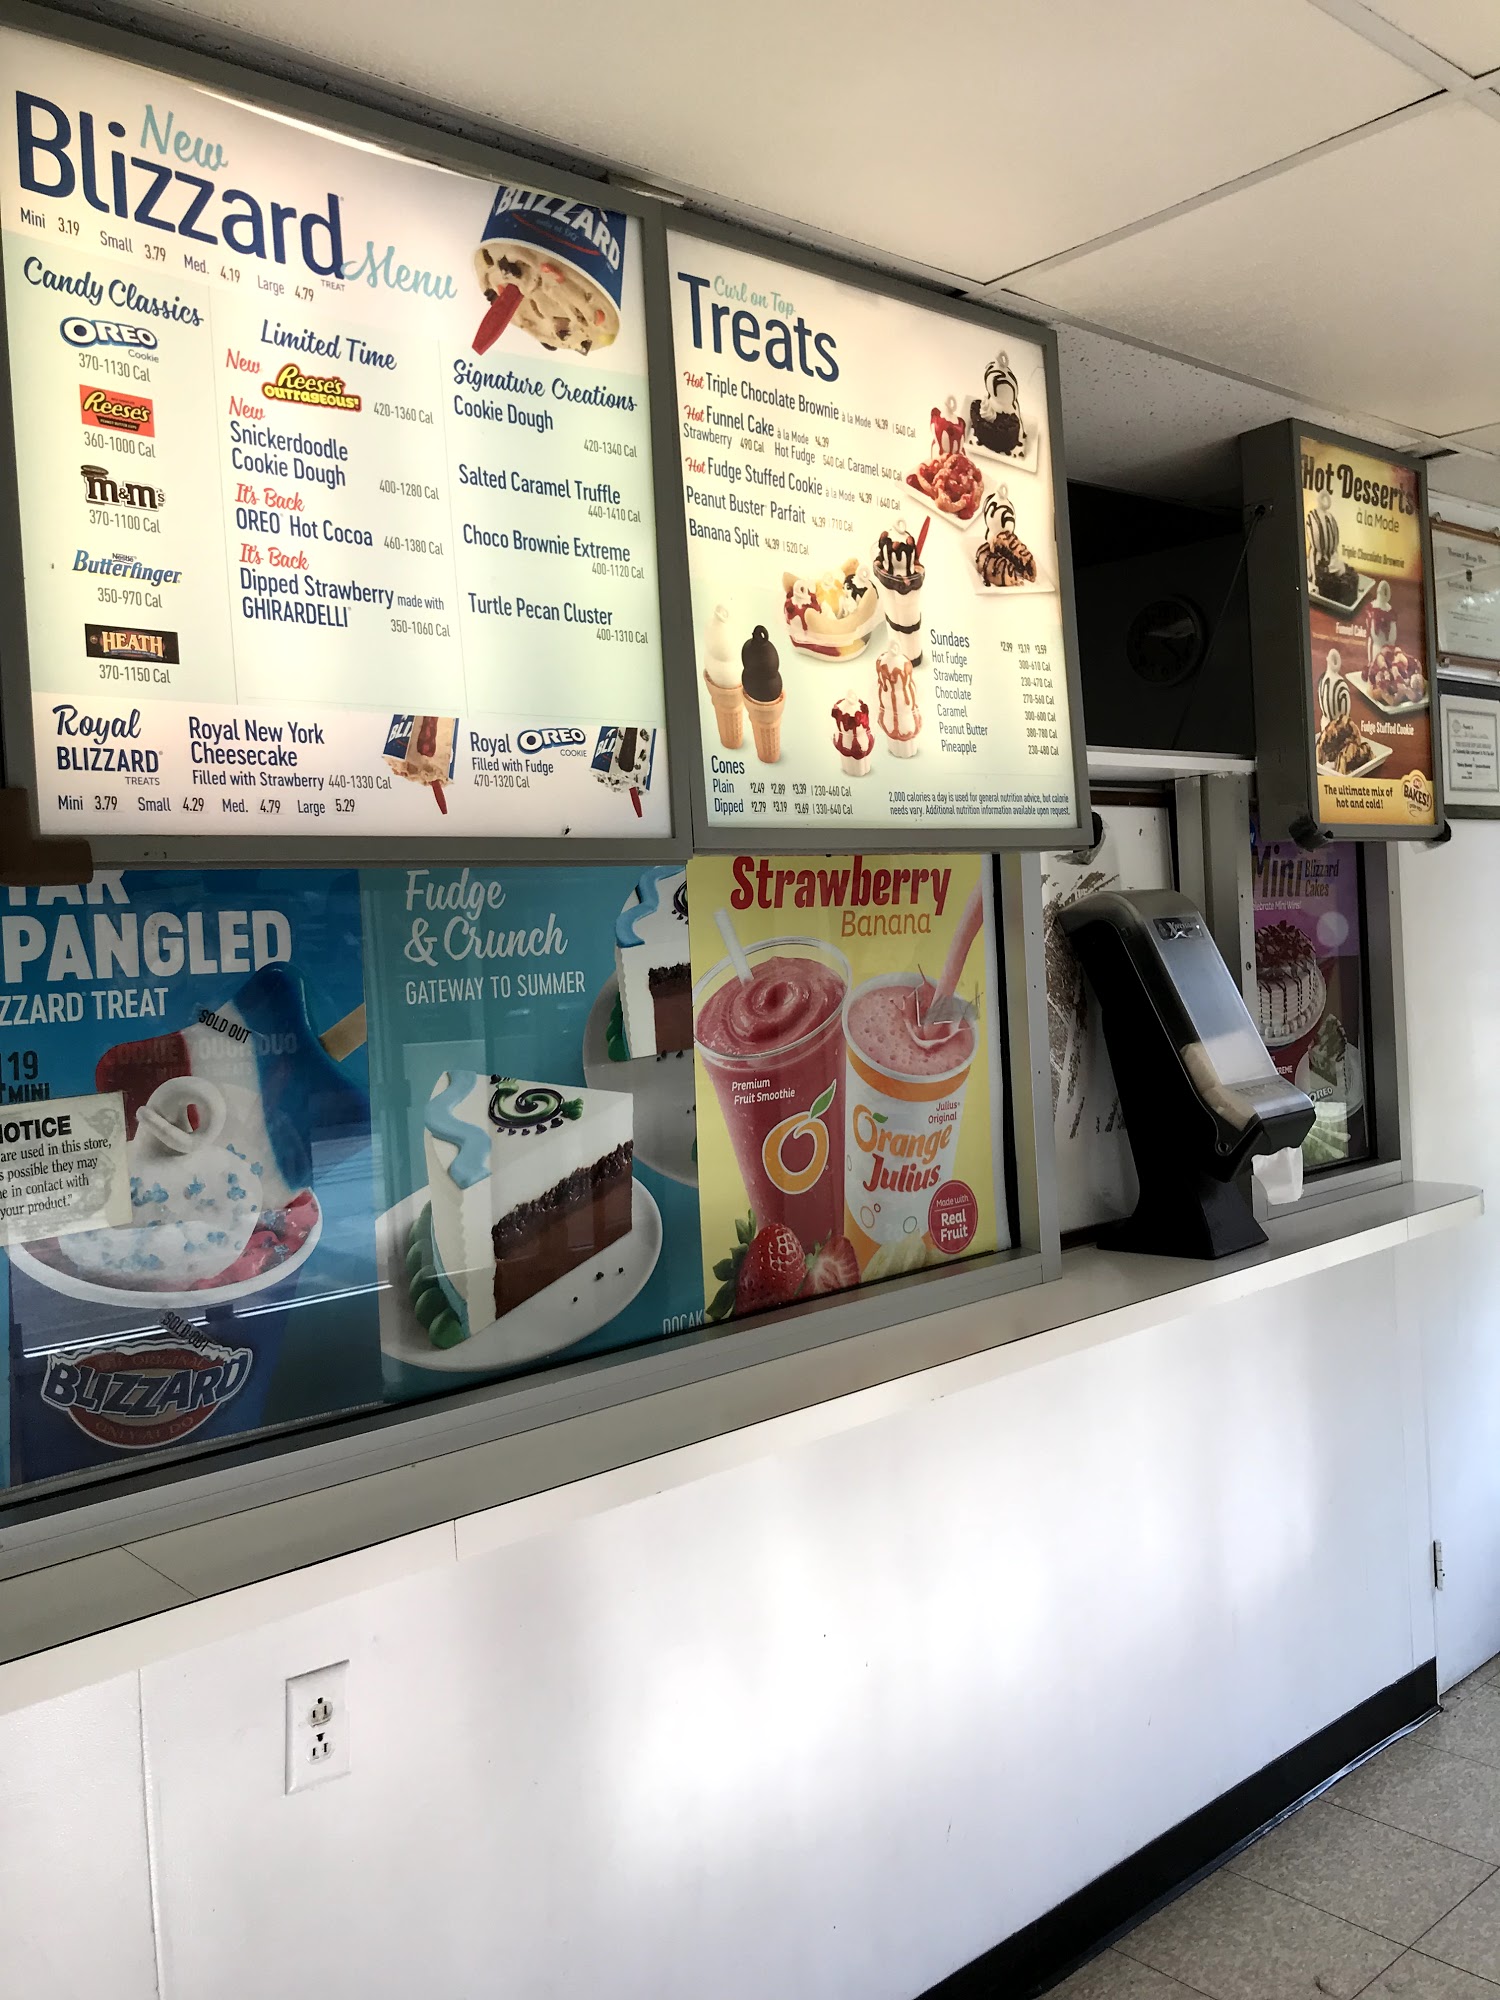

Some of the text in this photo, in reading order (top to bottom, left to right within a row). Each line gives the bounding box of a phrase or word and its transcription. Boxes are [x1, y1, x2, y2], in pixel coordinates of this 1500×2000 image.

[140, 104, 228, 171] New
[16, 90, 345, 279] Blizzard
[20, 207, 314, 302] Mini 3.19 Small 3.79 Med. 4.19 Large 4.79
[341, 241, 457, 299] Menu
[24, 256, 204, 326] Candy Classics
[714, 276, 796, 319] Curl on Top
[60, 317, 158, 349] OREO
[678, 272, 840, 382] Treats
[261, 318, 397, 371] Limited Time
[79, 353, 151, 382] 370-1130 Cal
[226, 348, 262, 374] New
[453, 359, 638, 411] Signature Creations
[683, 372, 840, 420] Hot Triple Chocolate Brownie
[83, 391, 151, 422] Reese's
[229, 395, 265, 420] New
[453, 395, 554, 433] Cookie Dough
[683, 405, 774, 436] Hot Funnel Cake
[230, 421, 348, 461] Snickerdoodle
[683, 423, 879, 477] Strawberry Hot Fudge Caramel
[232, 448, 346, 489] Cookie Dough
[684, 457, 823, 495] Hot Fudge Stuffed Cookie
[235, 483, 305, 512] It's Back
[459, 464, 621, 504] Salted Caramel Truffle
[1301, 454, 1416, 516] Hot Desserts
[686, 486, 806, 524] Peanut Buster Parfait
[236, 507, 373, 546] OREO Hot Cocoa
[689, 519, 760, 549] Banana Split
[463, 523, 631, 562] Choco Brownie Extreme
[72, 549, 182, 586] Butterfinger
[240, 568, 394, 609] Dipped Strawberry
[242, 597, 348, 628] GHIRARDELLI
[468, 592, 613, 626] Turtle Pecan Cluster
[101, 631, 164, 658] HEATH
[930, 629, 970, 649] Sundaes
[933, 669, 972, 685] Strawberry
[935, 686, 972, 700] Chocolate
[52, 704, 142, 745] Royal
[937, 704, 968, 718] Caramel
[188, 716, 325, 745] Royal New York
[470, 732, 511, 753] Royal
[518, 728, 586, 753] OREO
[939, 722, 988, 736] Peanut Butter
[1361, 720, 1414, 735] Fudge Stuffed Cookie
[57, 746, 159, 773] BLIZZARD
[191, 741, 299, 766] Cheesecake
[941, 740, 977, 755] Pineapple
[711, 755, 745, 774] Cones
[192, 769, 325, 791] Filled with Strawberry
[712, 779, 807, 795] Plain $2.49 $2.89 $3.39
[1324, 785, 1393, 797] The ultimate mix of
[57, 794, 355, 817] Mini 3.79 Small 4.29 Med. 4.79 Large 5.29
[714, 798, 744, 815] Dipped
[926, 805, 1036, 815] Additional nutrition information available
[1336, 798, 1383, 809] hot and cold!
[1403, 785, 1430, 807] BAKES!
[1305, 859, 1339, 877] Blizzard
[406, 868, 506, 921] Fudge
[731, 855, 951, 915] Strawberry
[1305, 879, 1329, 897] Cakes
[841, 910, 932, 937] Banana
[2, 909, 292, 983] PANGLED
[404, 913, 568, 967] & Crunch
[406, 971, 586, 1005] GATEWAY TO SUMMER
[91, 987, 168, 1020] TREAT
[199, 1009, 252, 1045] SOLD OUT
[731, 1077, 770, 1092] Premium
[734, 1086, 795, 1106] Fruit Smoothie
[928, 1111, 957, 1125] Original
[936, 1101, 958, 1112] Julius
[853, 1104, 952, 1165] Orange
[1, 1137, 112, 1163] are used in this store,
[7, 1164, 49, 1183] possible
[52, 1159, 74, 1175] they
[77, 1157, 98, 1169] may
[863, 1153, 941, 1193] Julius
[12, 1185, 22, 1198] in
[25, 1179, 64, 1196] contact
[66, 1174, 89, 1188] with
[1, 1204, 24, 1220] your
[936, 1195, 969, 1208] Made with
[941, 1208, 966, 1227] Real
[940, 1225, 968, 1243] Fruit
[161, 1311, 208, 1351] SOLD OUT
[43, 1352, 250, 1418] BLIZZARD
